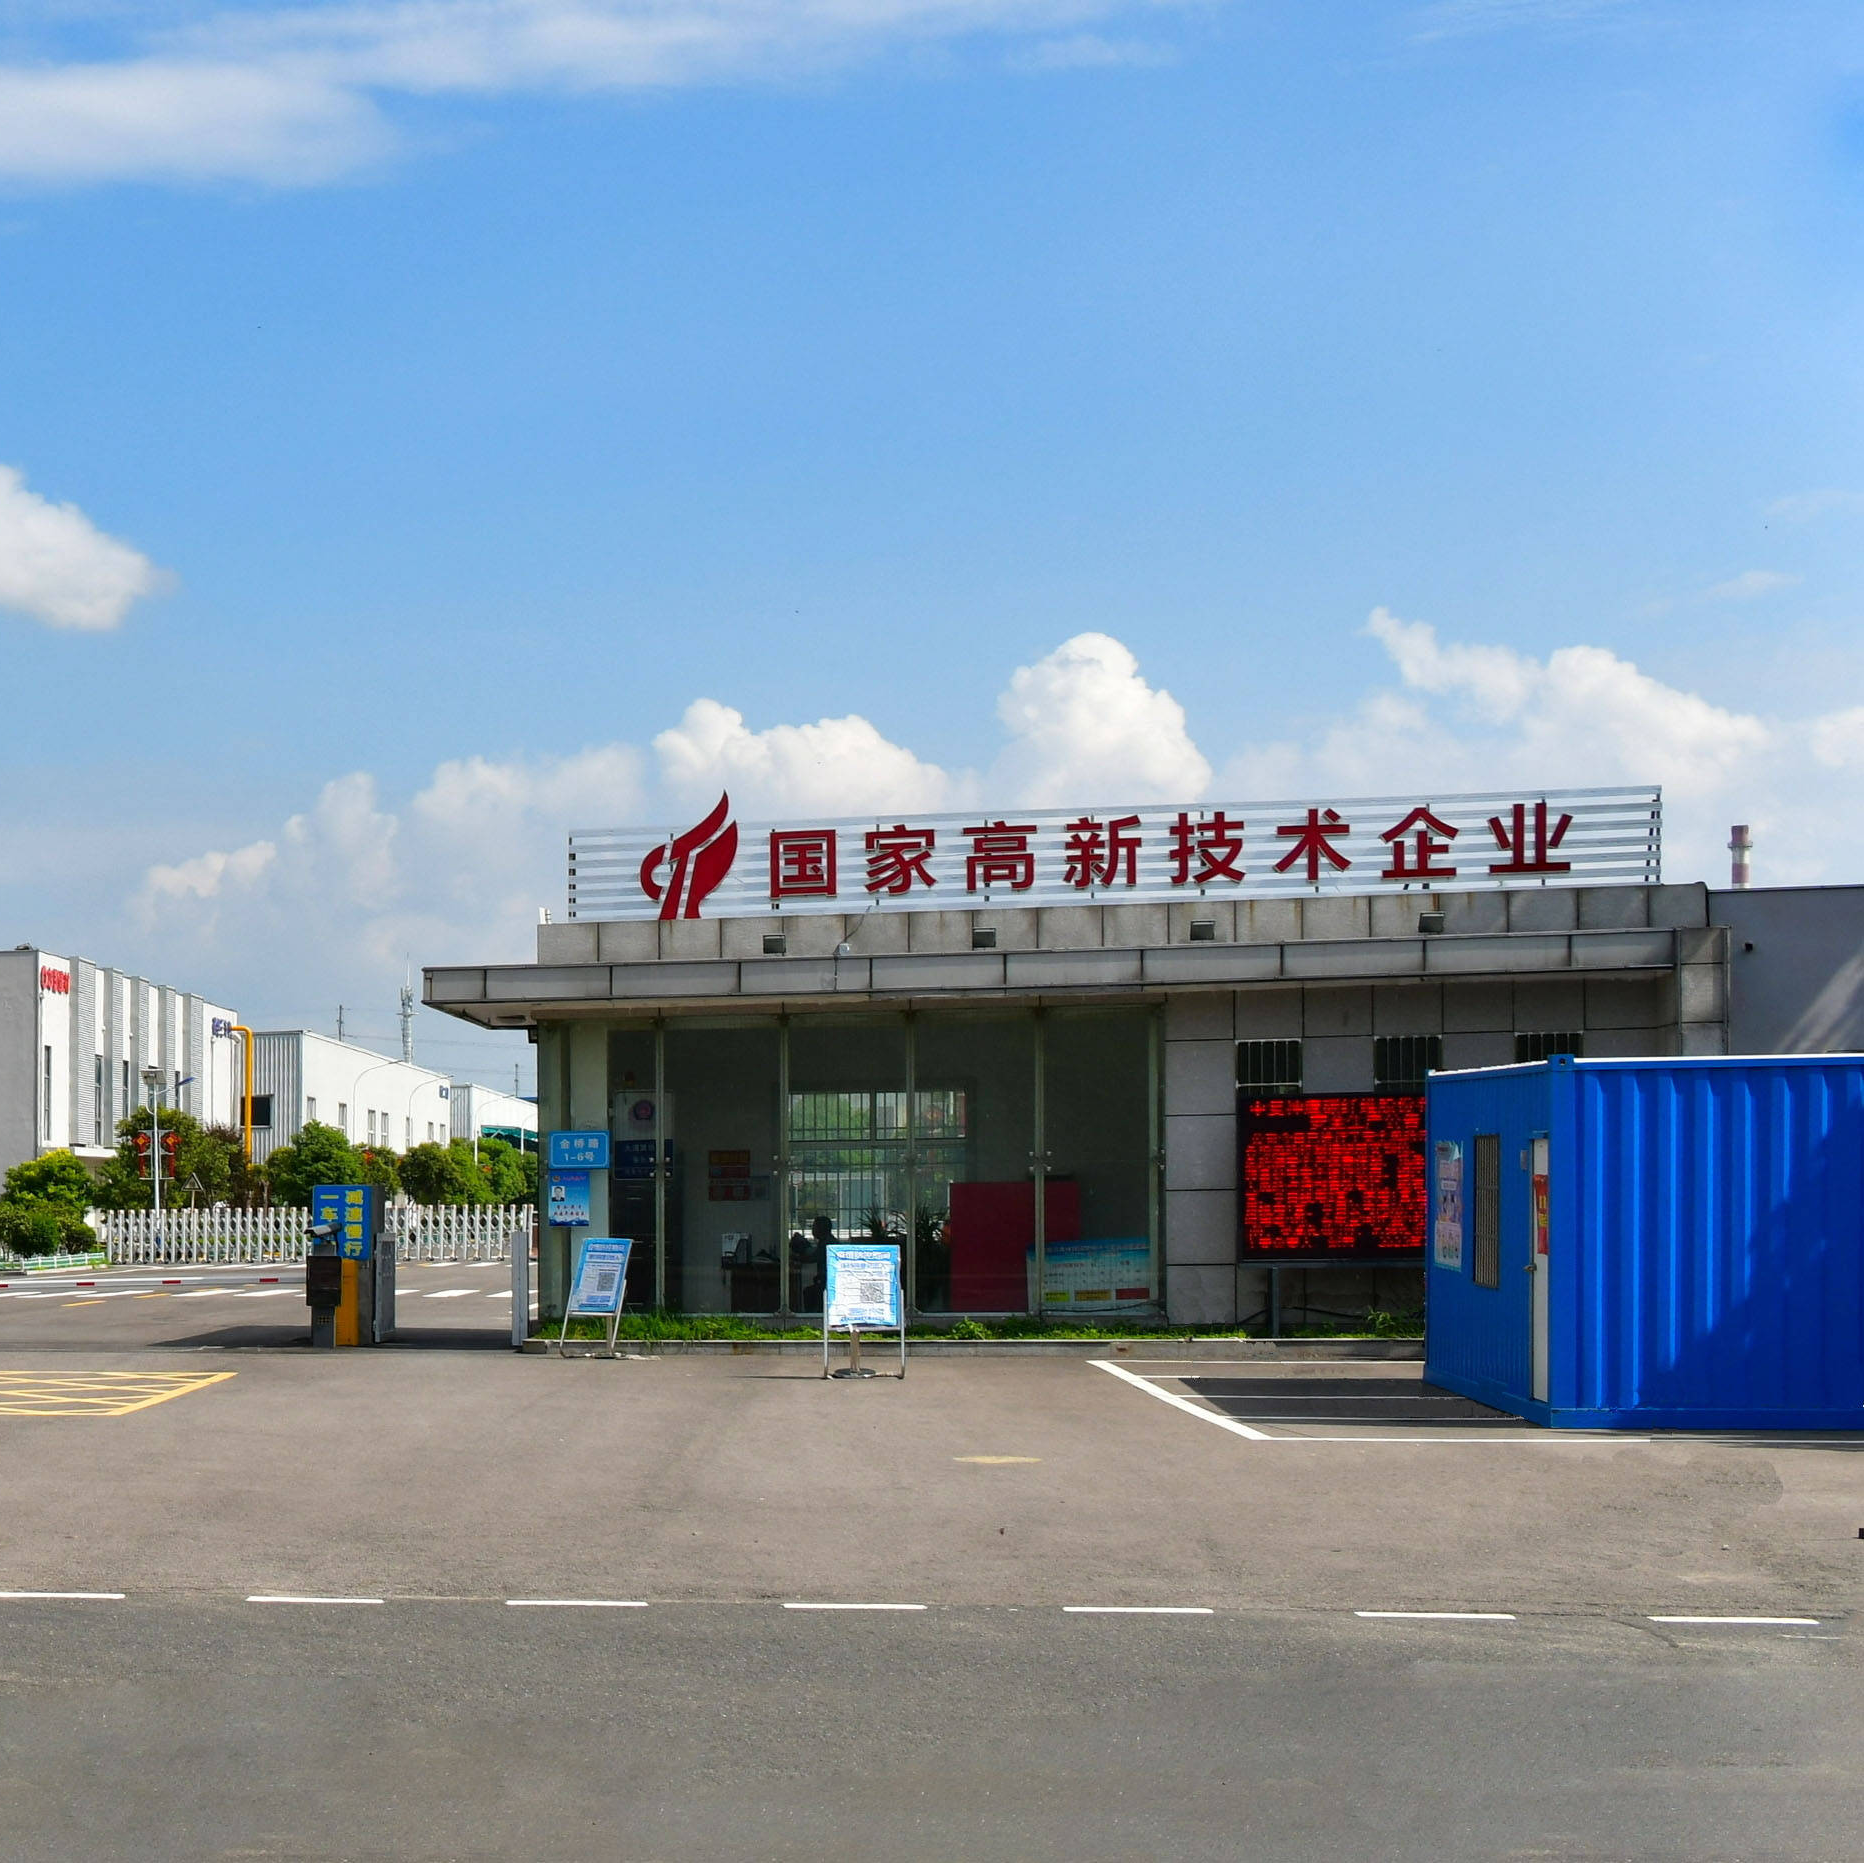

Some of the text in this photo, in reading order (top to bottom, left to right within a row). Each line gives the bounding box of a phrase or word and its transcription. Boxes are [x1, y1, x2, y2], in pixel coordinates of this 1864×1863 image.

[769, 801, 1573, 898] 国家高新技术企业
